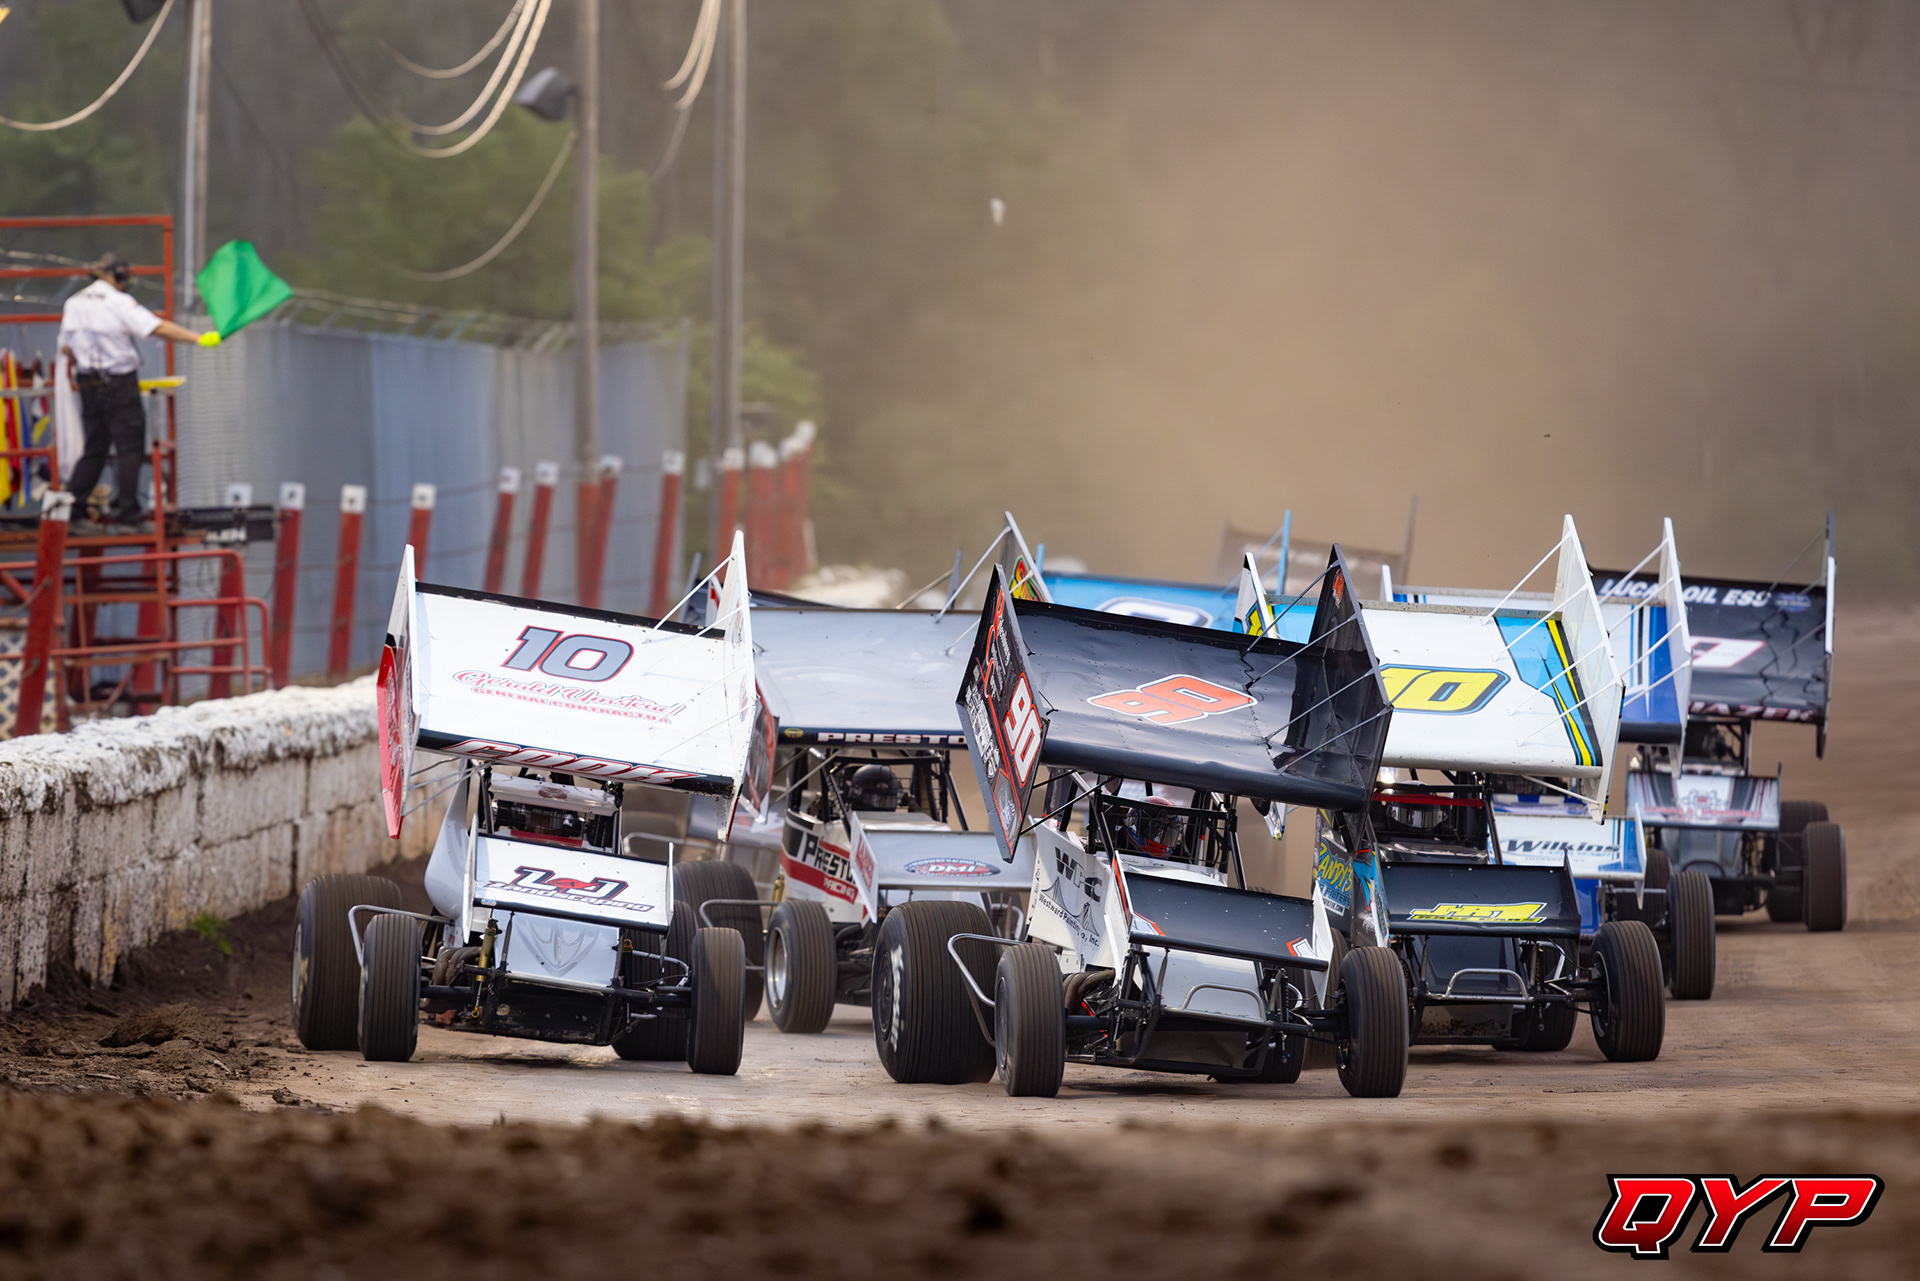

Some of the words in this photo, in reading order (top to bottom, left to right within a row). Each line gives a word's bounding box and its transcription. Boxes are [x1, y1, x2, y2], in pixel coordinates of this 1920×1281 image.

[1599, 578, 1661, 600] LUCA
[1682, 585, 1718, 604] OIL
[501, 625, 634, 682] 10
[453, 669, 559, 696] Gerald
[471, 686, 551, 705] GENERAL
[551, 699, 672, 725] CONTRACTOR
[817, 732, 967, 745] PRESTO
[1003, 671, 1043, 787] 90
[441, 739, 705, 784] COOK
[802, 833, 856, 884] PRESTO
[1507, 839, 1621, 853] Wilkins
[928, 864, 976, 873] DMI
[1055, 846, 1103, 903] WPC
[1325, 887, 1351, 907] FILTERS
[1038, 892, 1064, 919] Westward
[1088, 935, 1100, 948] Inc.
